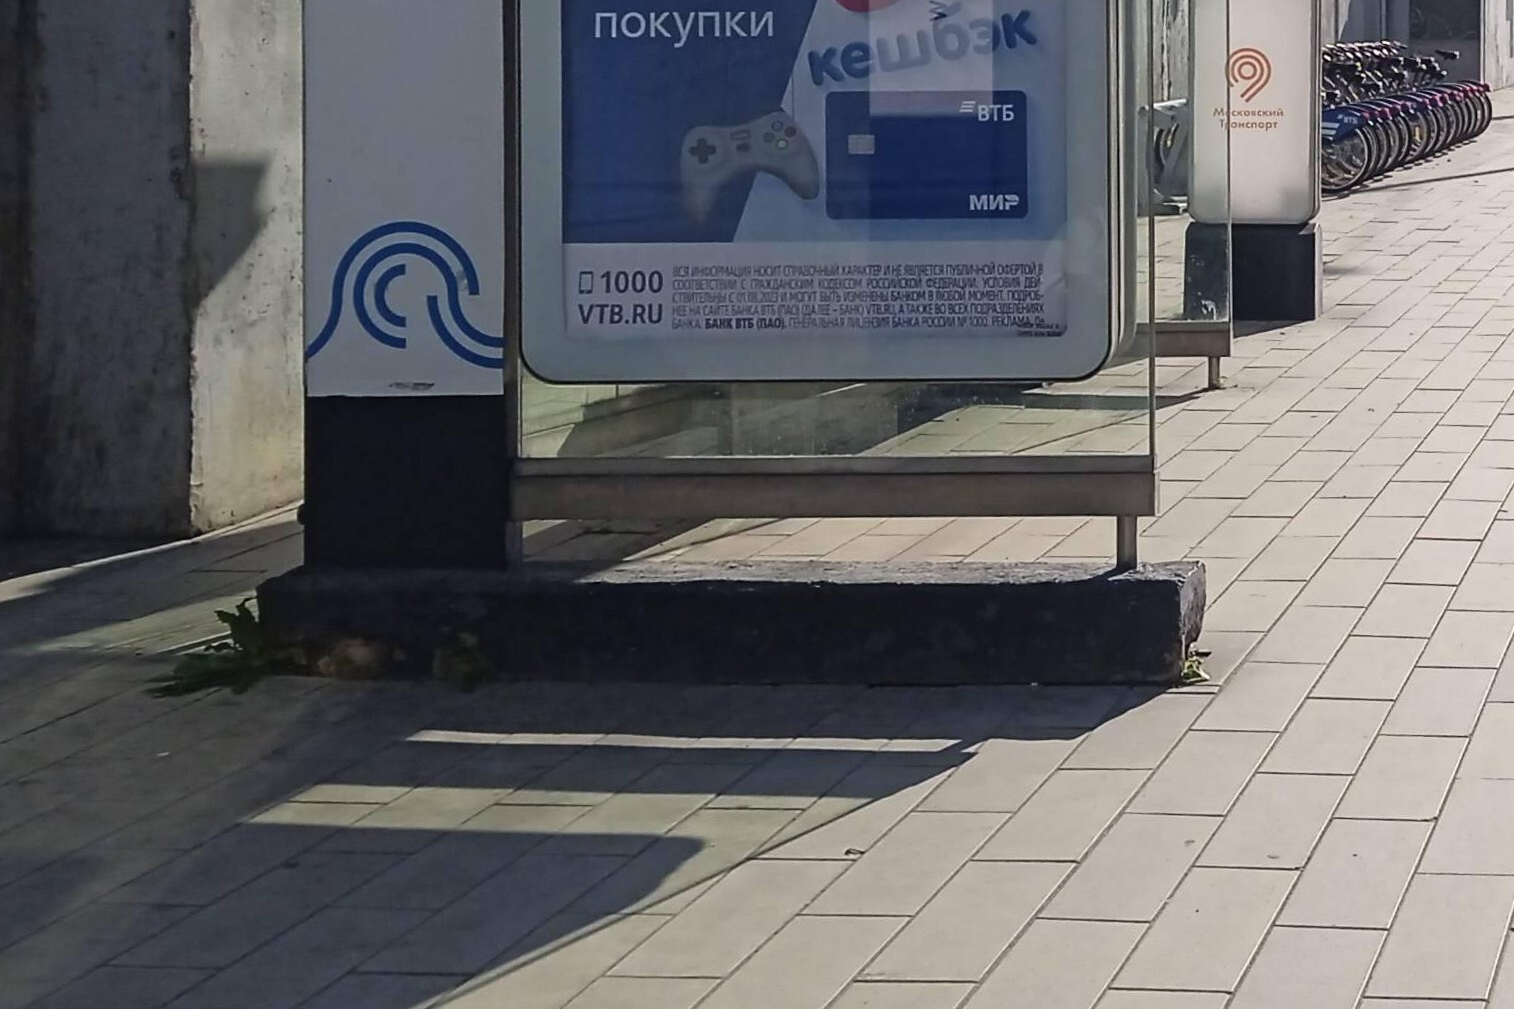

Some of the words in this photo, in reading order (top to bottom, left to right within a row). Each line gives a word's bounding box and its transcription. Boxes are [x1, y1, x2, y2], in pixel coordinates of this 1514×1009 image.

[595, 9, 774, 47] покупки
[807, 5, 1037, 87] кешбэк
[976, 104, 1015, 122] ВТБ
[969, 194, 1019, 212] МИР
[600, 270, 663, 294] 1000
[578, 303, 663, 324] VTB.RU
[705, 317, 733, 329] БАНК
[735, 317, 754, 329] ВТБ
